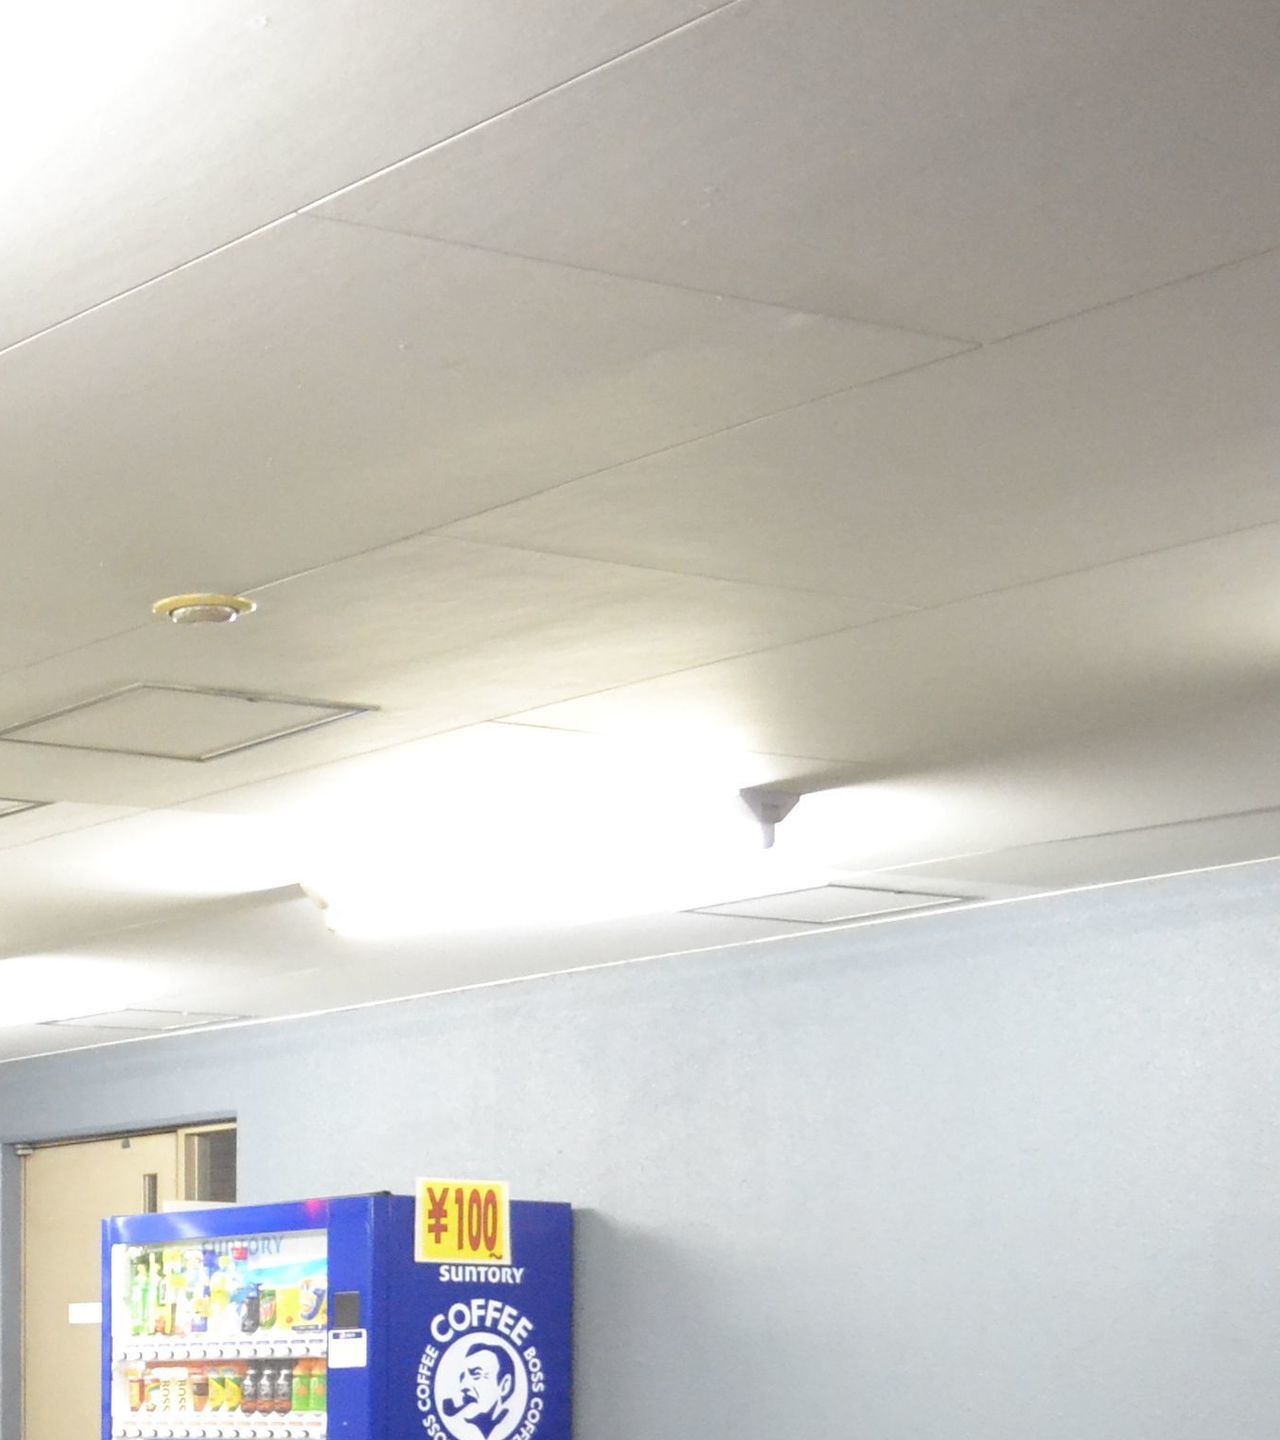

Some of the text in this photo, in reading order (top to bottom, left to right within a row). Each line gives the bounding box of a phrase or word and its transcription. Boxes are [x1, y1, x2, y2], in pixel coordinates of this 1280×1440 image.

[430, 1298, 534, 1347] COFFEE
[416, 1344, 440, 1413] COFFEE
[523, 1346, 546, 1393] BOSS
